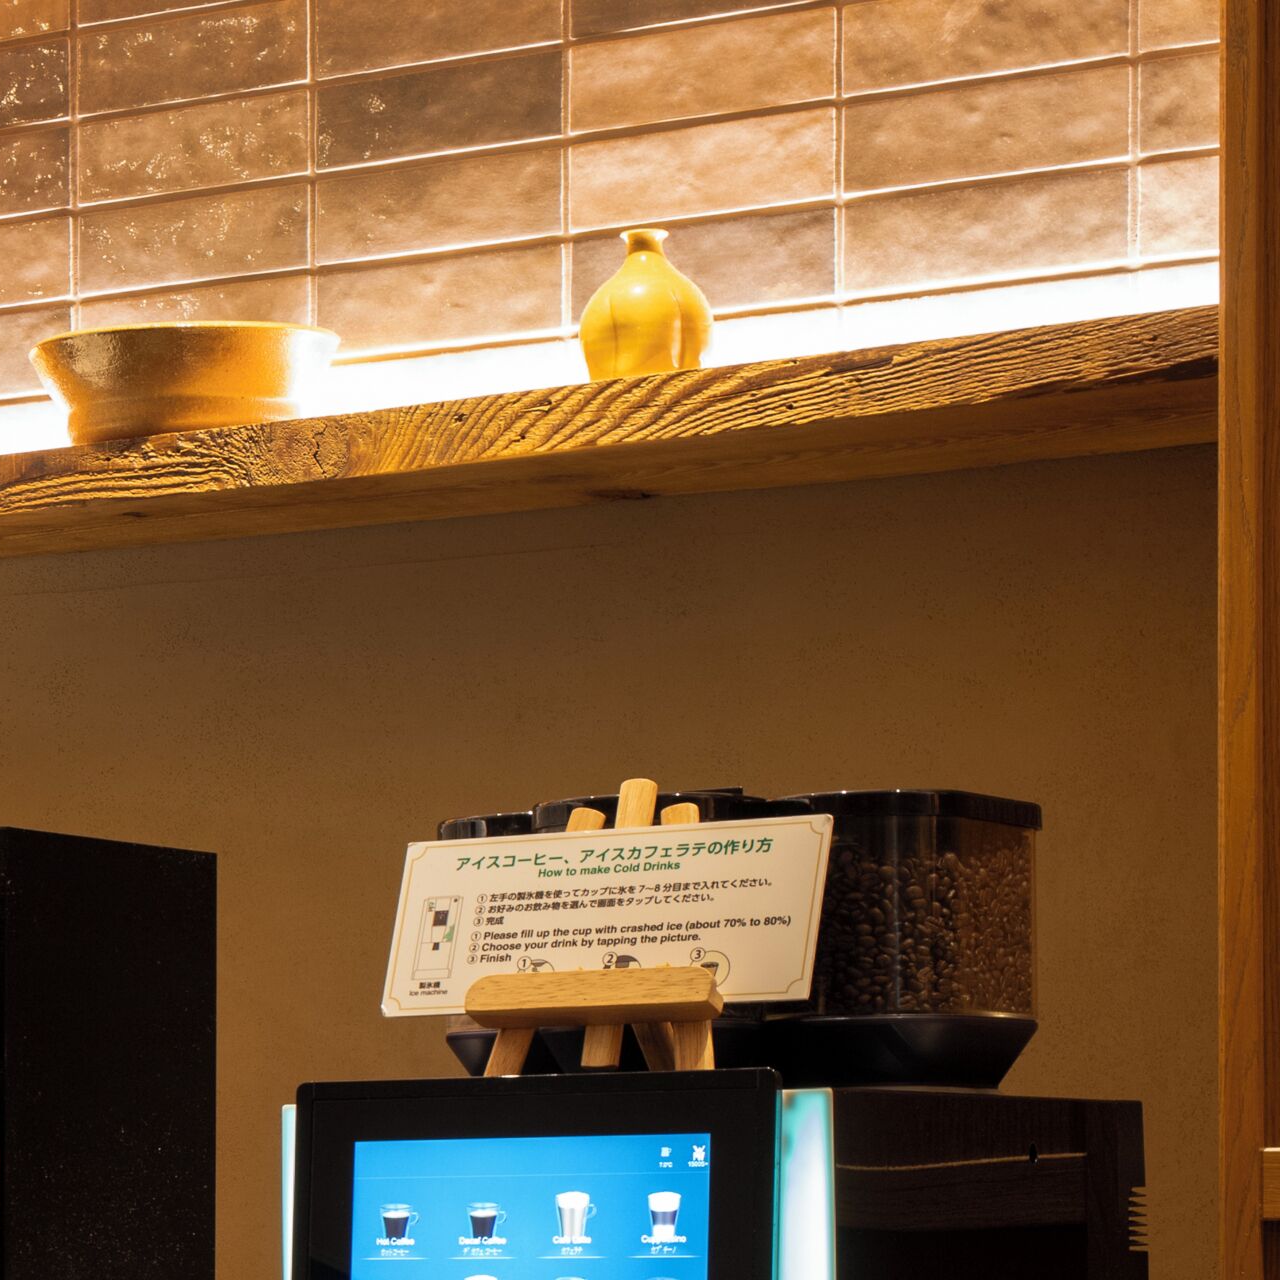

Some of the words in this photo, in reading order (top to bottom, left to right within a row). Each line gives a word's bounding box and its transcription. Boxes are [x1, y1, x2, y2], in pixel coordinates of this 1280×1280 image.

[456, 837, 773, 871] アイスコーヒー、アイスカフェラテの作り方
[538, 868, 562, 878] How
[566, 868, 577, 876] to
[580, 866, 610, 875] make
[614, 863, 640, 874] Cold
[643, 861, 680, 872] Drinks
[485, 916, 504, 926] 完成
[483, 931, 518, 941] Please
[521, 929, 533, 938] fill
[536, 930, 550, 939] up
[553, 928, 569, 937] the
[572, 927, 592, 937] cup
[595, 925, 617, 934] with
[620, 922, 663, 933] crashed
[666, 921, 682, 930] ice
[685, 919, 720, 931] (about
[724, 918, 747, 928] 70%
[750, 918, 760, 926] to
[763, 915, 791, 926] 80%)
[481, 942, 521, 952] Choose
[525, 941, 548, 950] your
[551, 939, 577, 948] drink
[581, 938, 594, 948] by
[597, 935, 638, 946] tapping
[640, 933, 657, 943] the
[660, 932, 701, 944] picture.
[479, 953, 512, 963] Finish
[390, 1237, 415, 1245] Coffee
[458, 1237, 481, 1245] Decaf
[482, 1237, 507, 1245] Coffee
